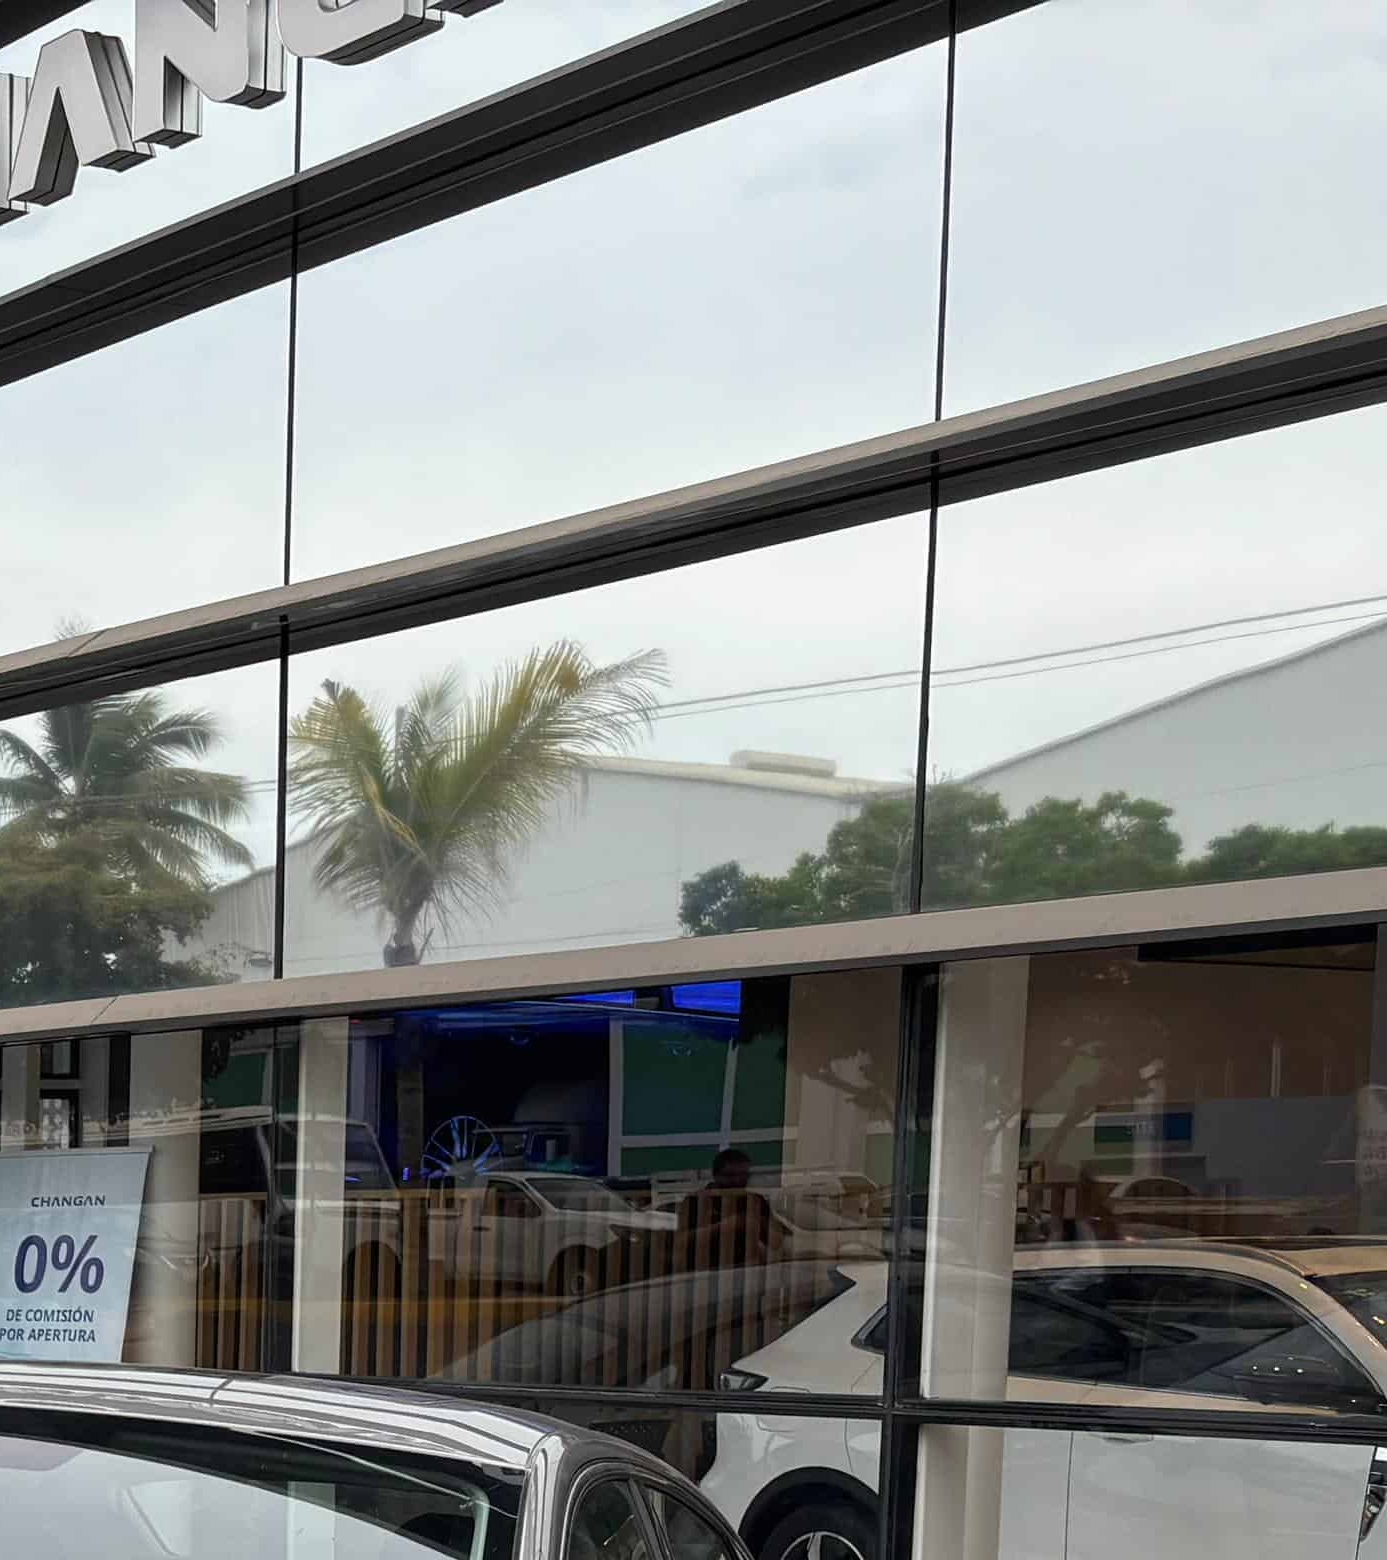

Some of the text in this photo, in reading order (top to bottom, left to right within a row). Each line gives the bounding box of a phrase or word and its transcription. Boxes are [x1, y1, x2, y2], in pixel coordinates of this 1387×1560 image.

[30, 1195, 106, 1208] CHANGAN
[14, 1234, 105, 1294] 0%
[5, 1306, 94, 1323] DE COMISIÓN
[0, 1327, 96, 1342] POR APERTURA
